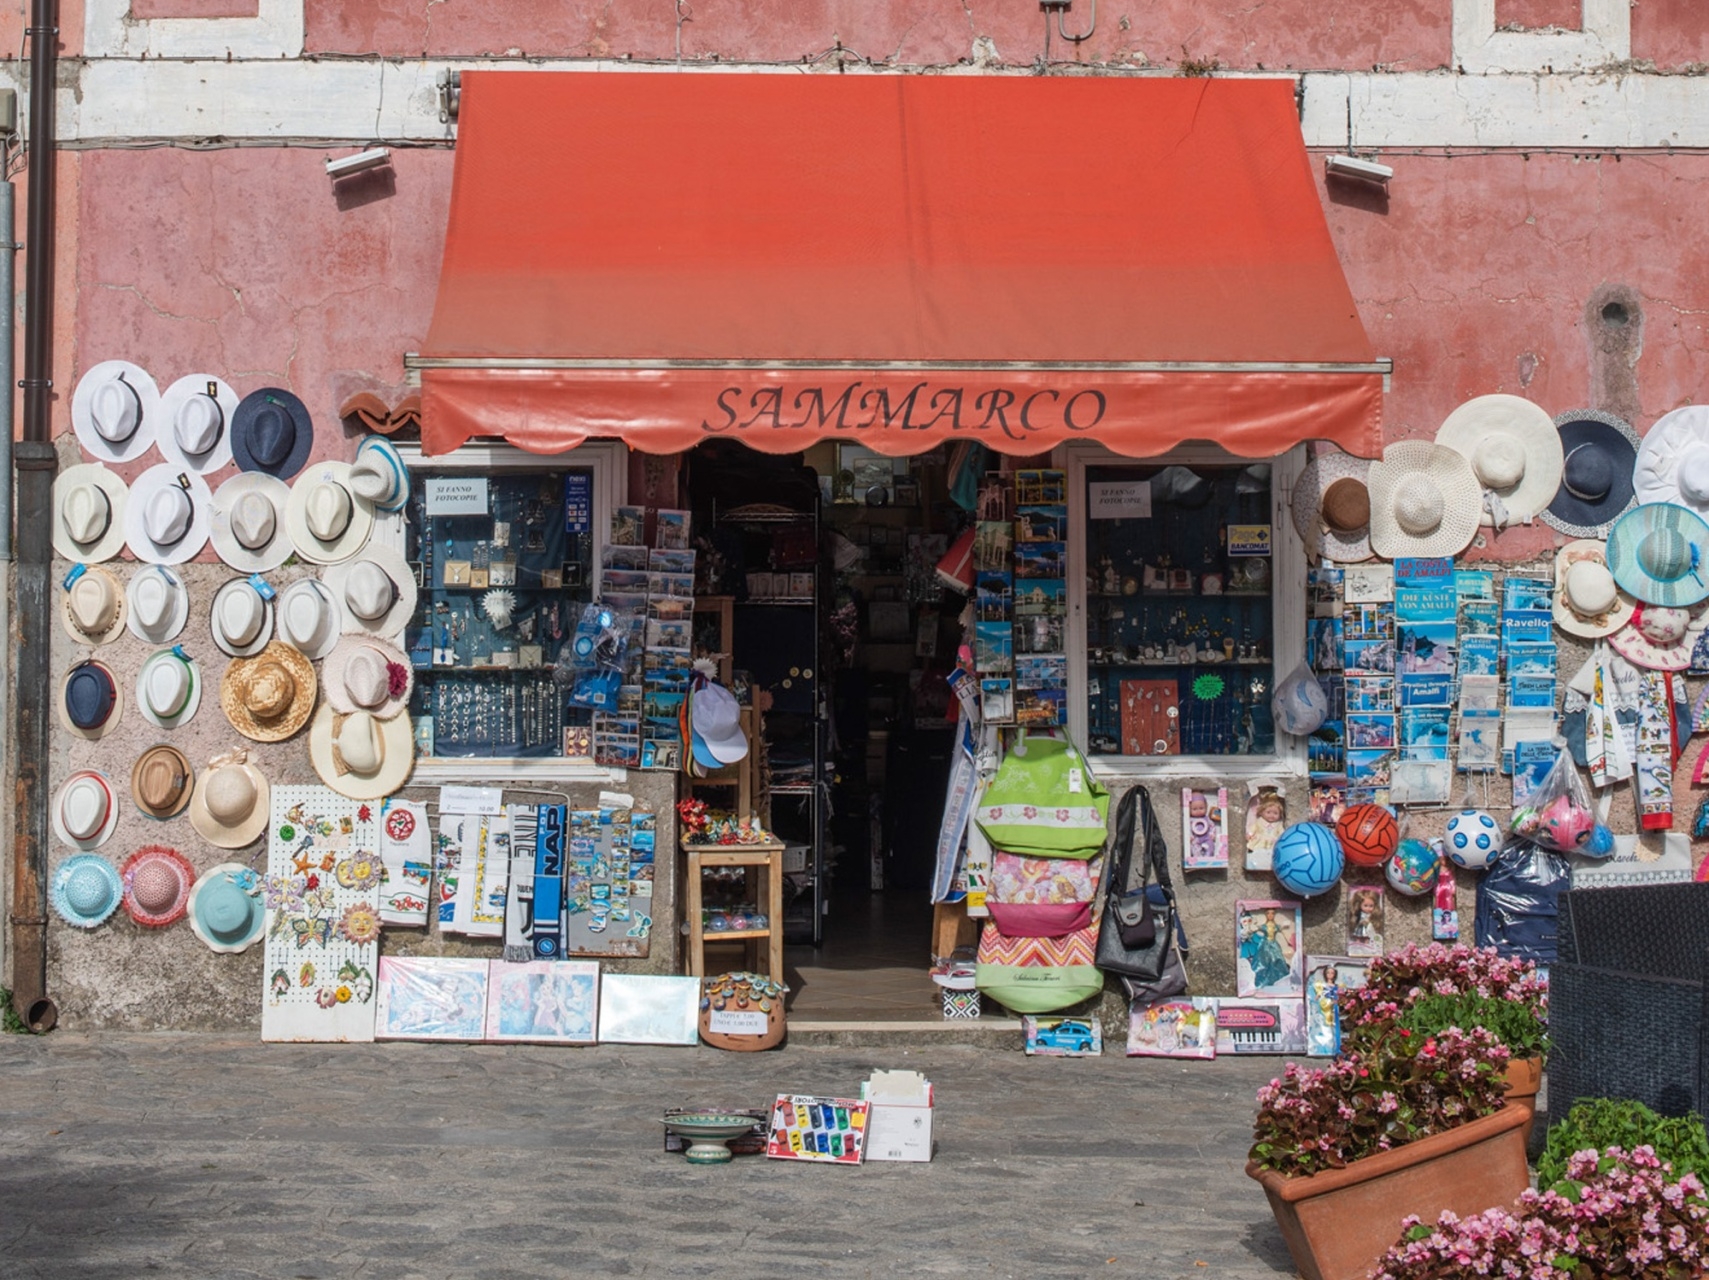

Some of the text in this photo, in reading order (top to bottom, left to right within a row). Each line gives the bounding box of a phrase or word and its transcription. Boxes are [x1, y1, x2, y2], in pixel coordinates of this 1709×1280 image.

[702, 381, 1107, 440] SAMMARCO
[435, 494, 478, 502] FOTOCOPIE
[1230, 527, 1257, 543] Pago
[1230, 542, 1269, 550] BANCOMAT
[1400, 559, 1449, 569] LA COSTA
[1397, 567, 1452, 577] DE AMALFI
[1402, 591, 1450, 602] DIE KÜSTE
[1398, 601, 1456, 609] VON AMALFI
[1506, 617, 1549, 628] Ravello
[1413, 686, 1440, 696] Amalfi
